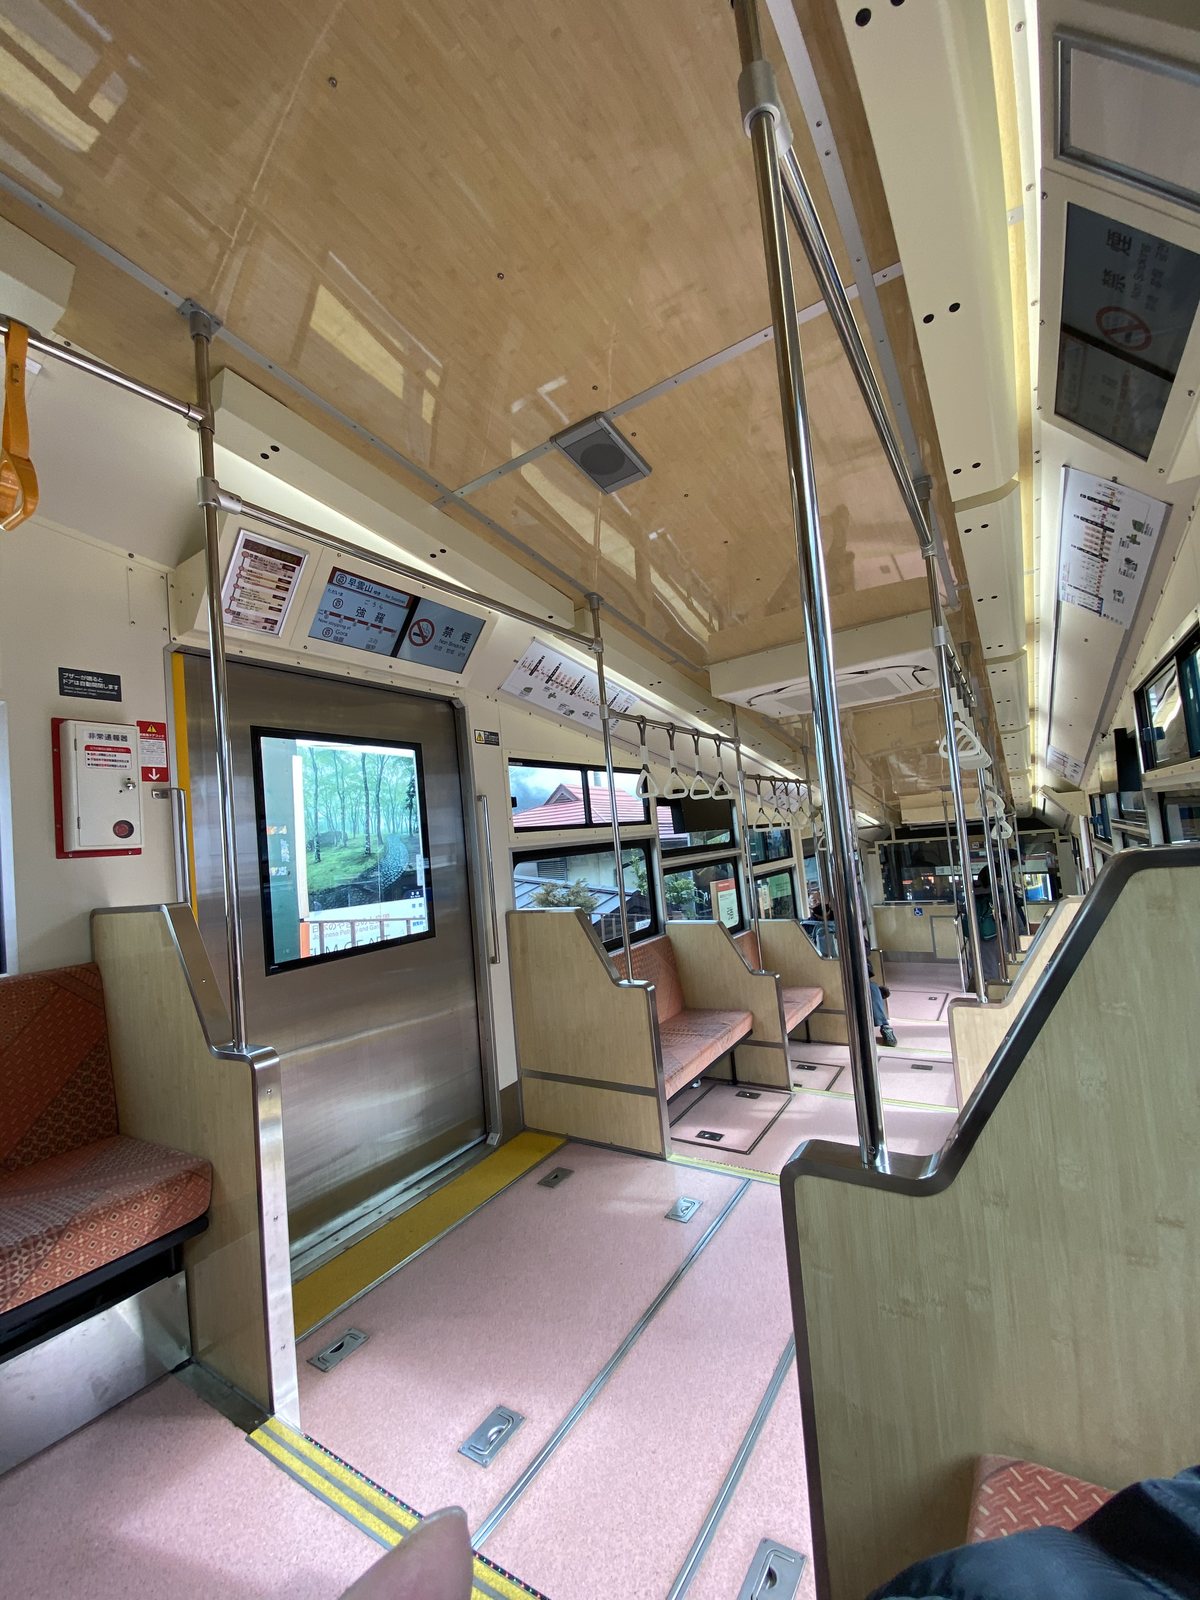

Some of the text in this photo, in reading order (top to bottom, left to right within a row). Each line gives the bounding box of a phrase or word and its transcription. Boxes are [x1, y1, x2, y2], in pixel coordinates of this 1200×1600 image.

[347, 577, 374, 594] 早雲山
[355, 606, 387, 625] 強羅
[335, 629, 349, 638] Gora
[442, 625, 472, 644] 禁煙
[87, 732, 128, 742] 非常通報器
